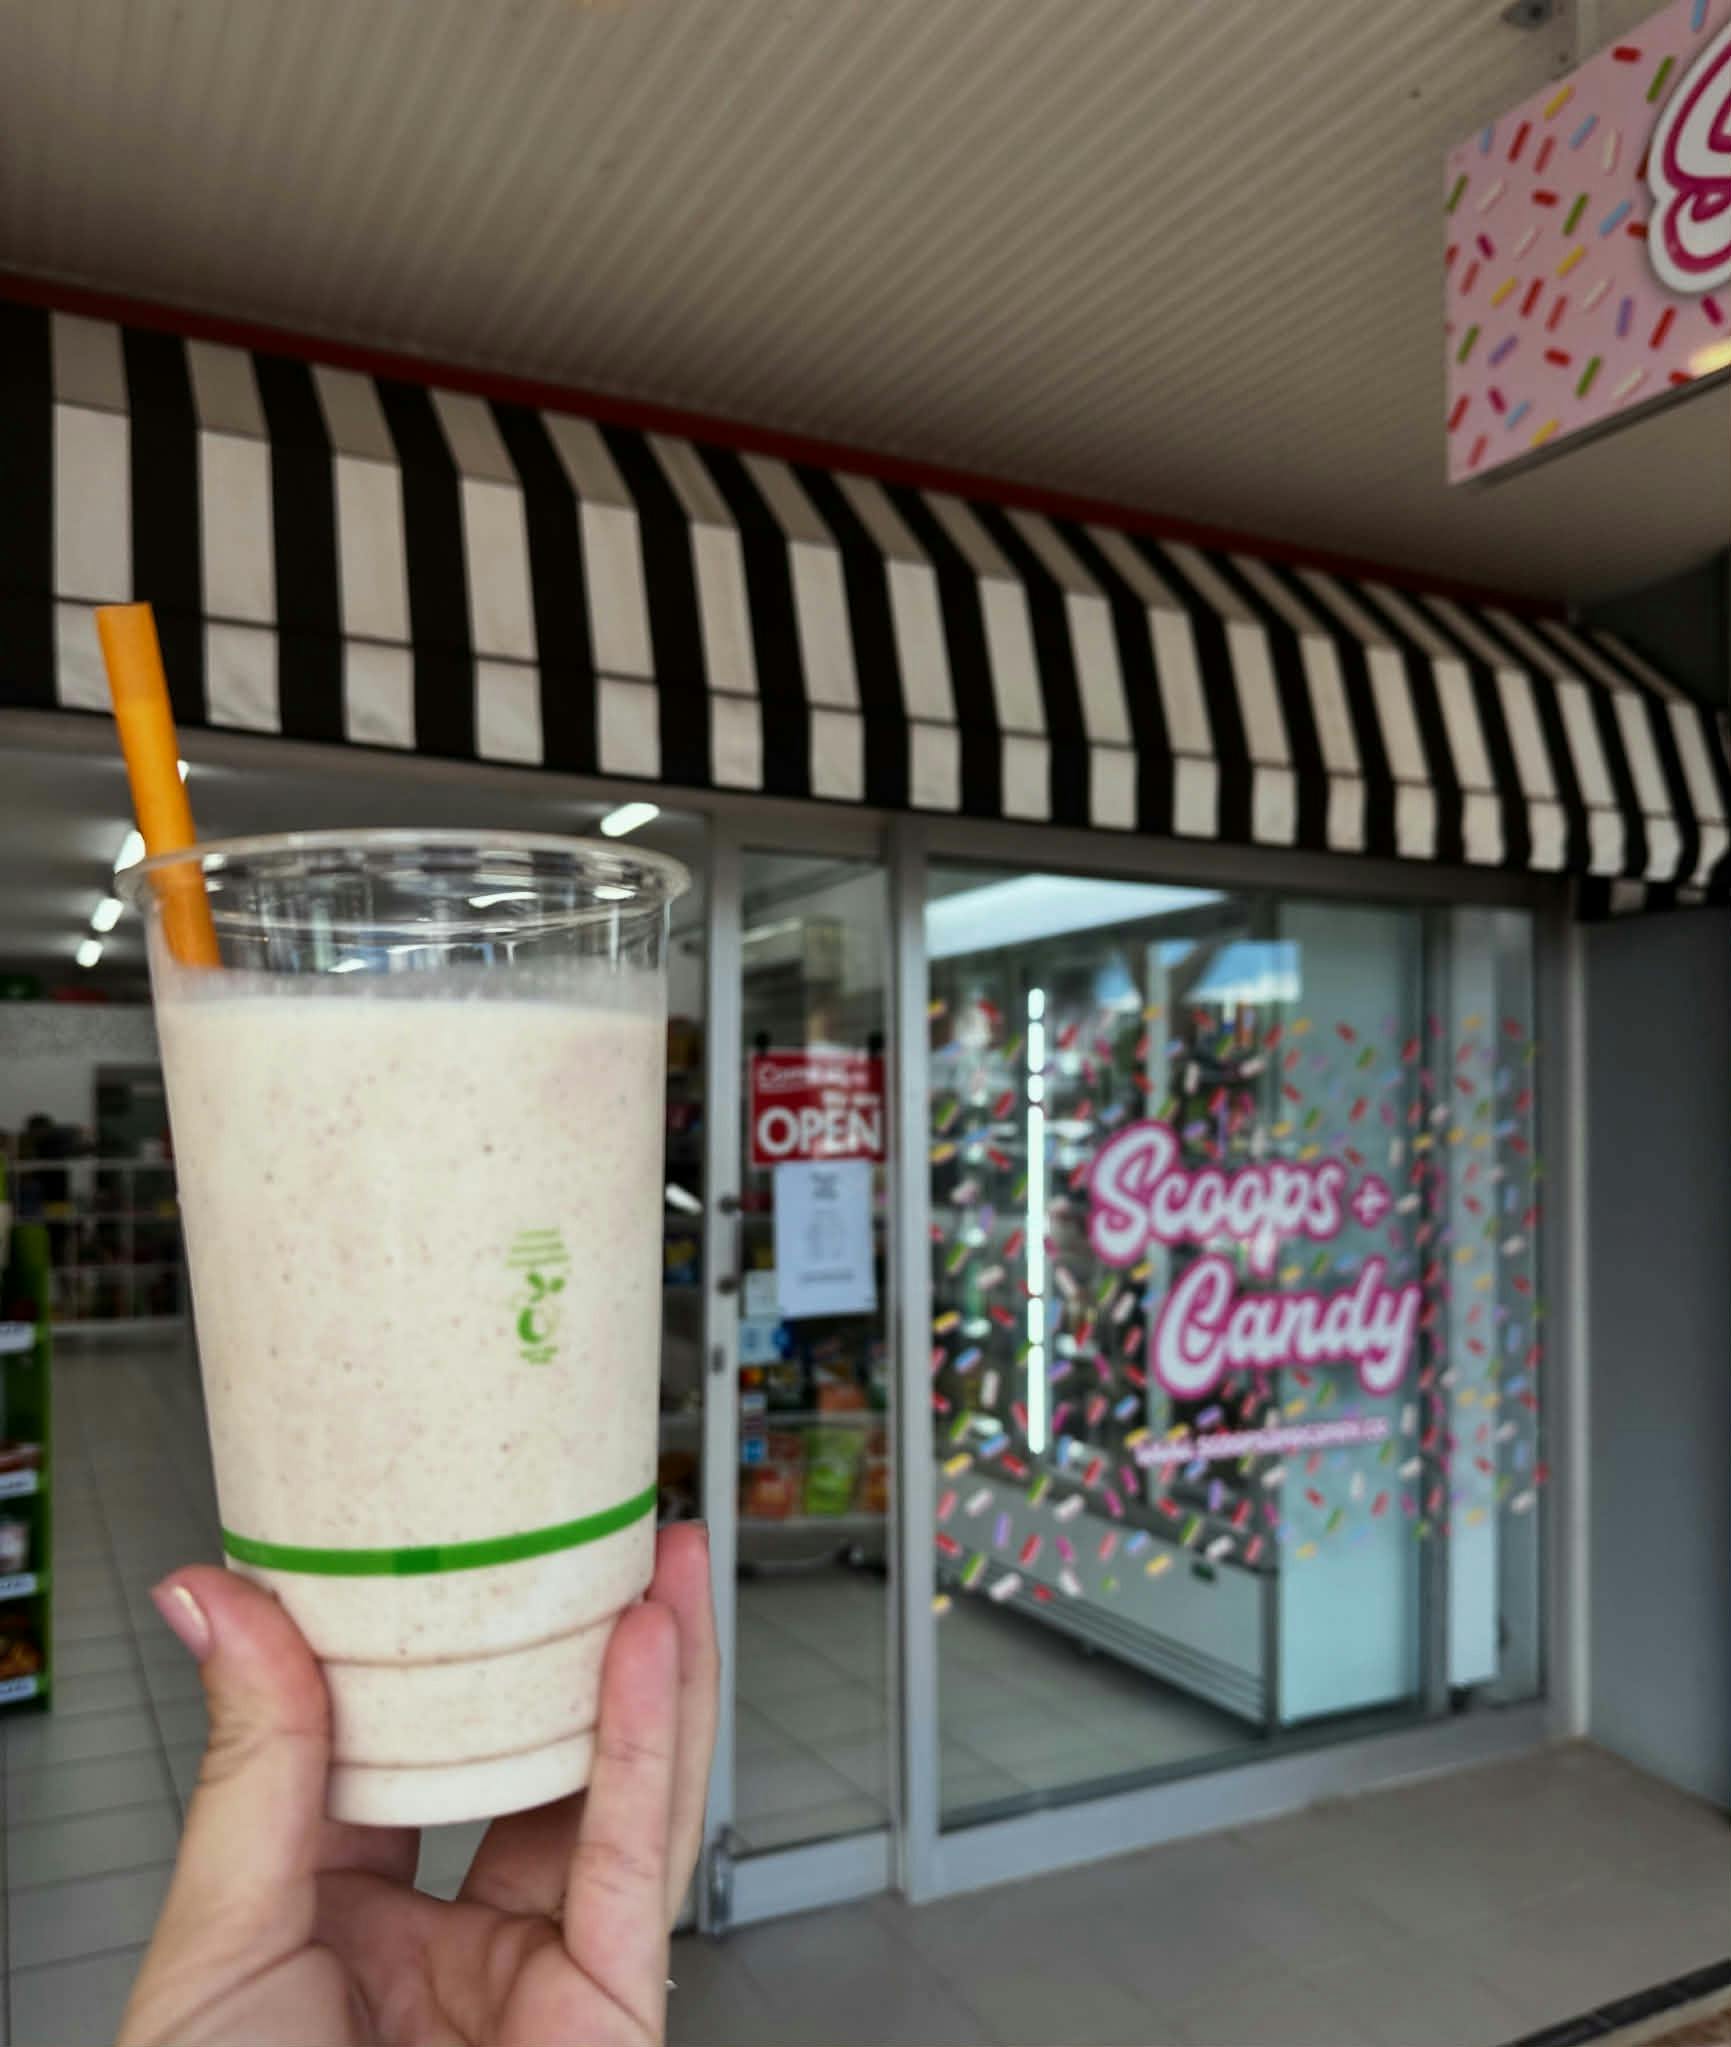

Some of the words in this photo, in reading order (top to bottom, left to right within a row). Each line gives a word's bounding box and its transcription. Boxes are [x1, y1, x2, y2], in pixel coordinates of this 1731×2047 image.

[758, 1106, 880, 1154] OPEN
[1090, 1122, 1343, 1277] Scoops
[1154, 1255, 1420, 1396] Candy
